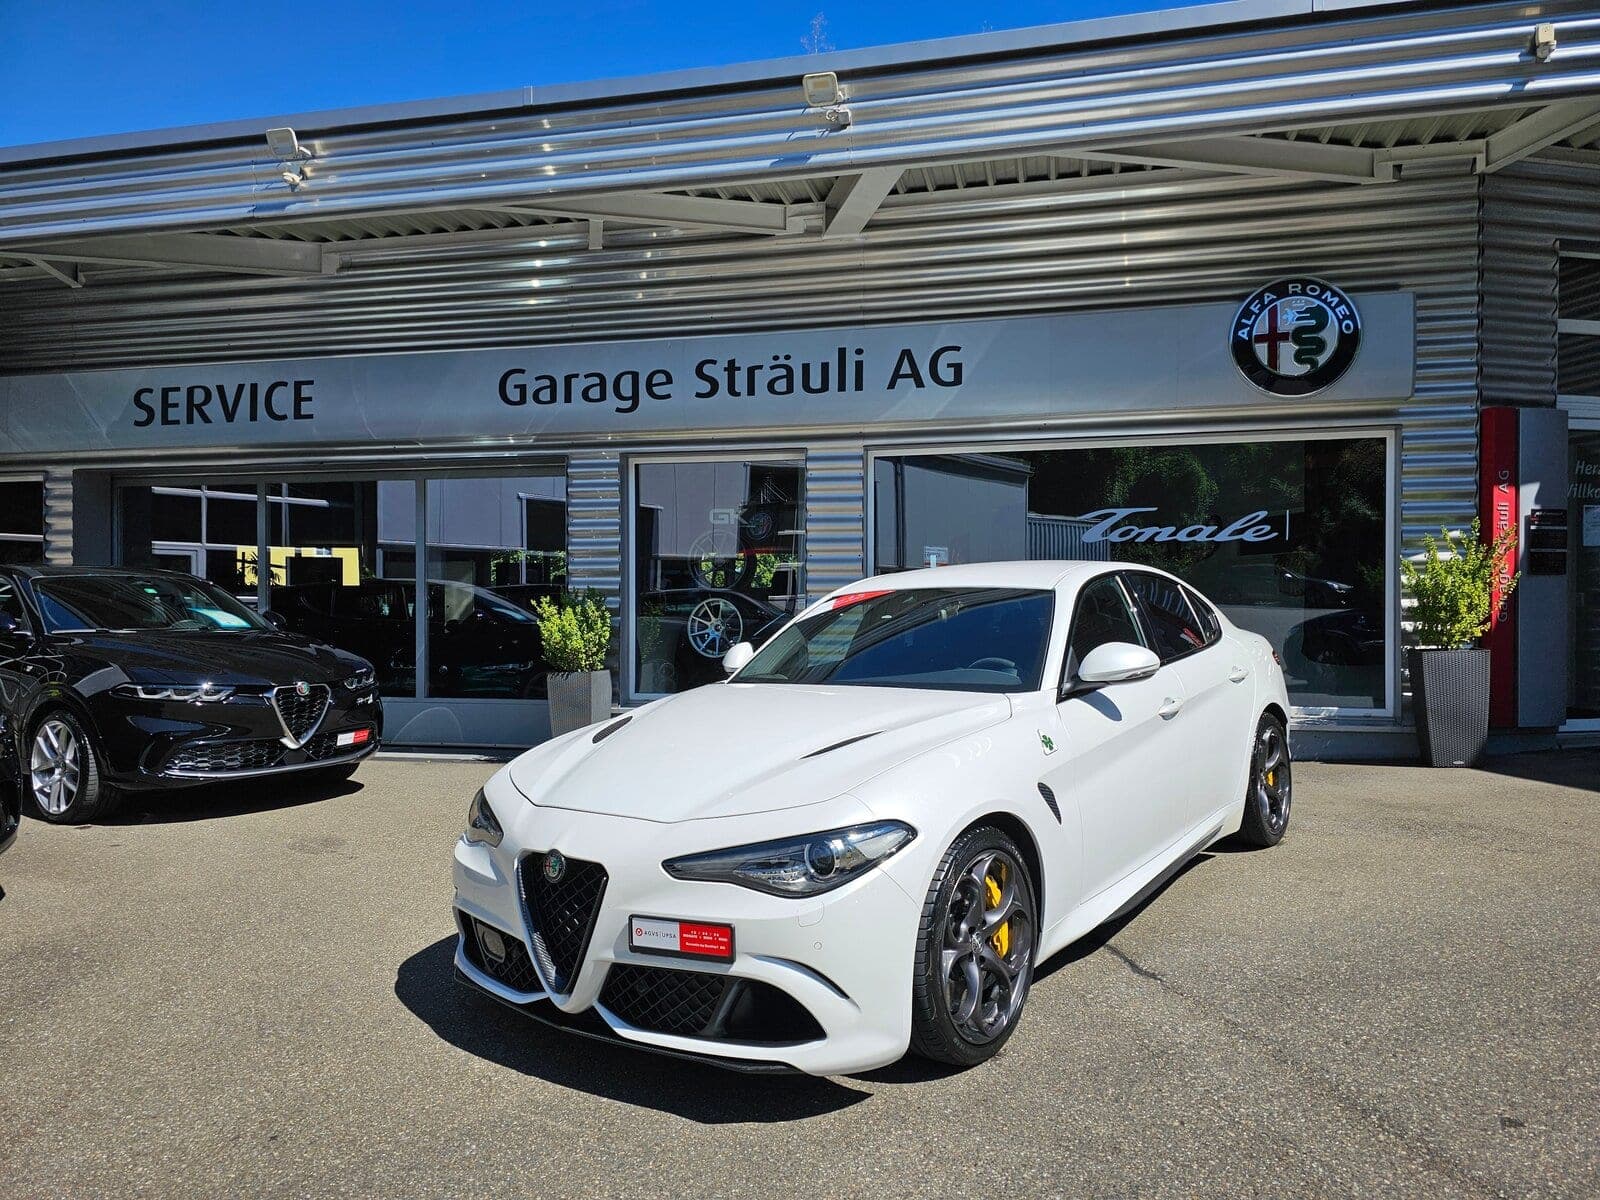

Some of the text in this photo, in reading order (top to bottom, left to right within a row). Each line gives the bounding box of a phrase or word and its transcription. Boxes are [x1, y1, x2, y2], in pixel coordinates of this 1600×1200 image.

[1237, 283, 1354, 340] ALFA ROMEO
[133, 379, 315, 427] SERVICE
[498, 344, 963, 414] Garage Sträuli AG
[1498, 470, 1510, 494] AG
[1076, 506, 1279, 543] Tonale
